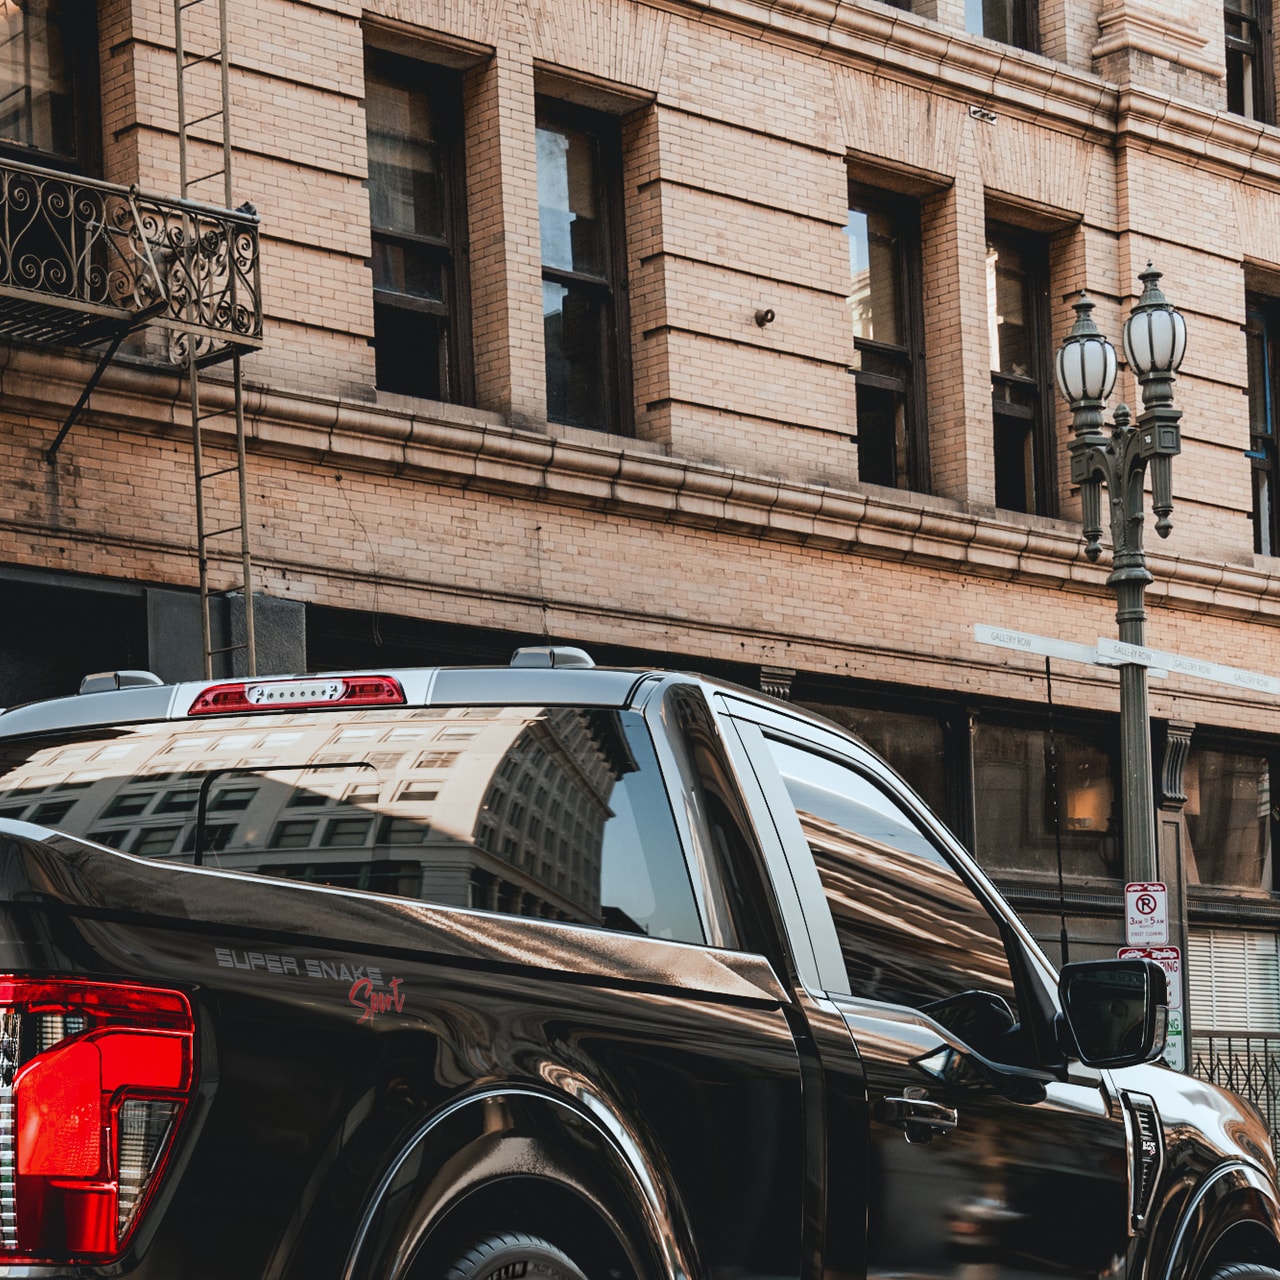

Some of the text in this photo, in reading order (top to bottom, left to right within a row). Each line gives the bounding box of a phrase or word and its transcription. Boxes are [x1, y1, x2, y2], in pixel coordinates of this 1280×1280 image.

[991, 631, 1032, 648] GALLERY ROW
[1113, 645, 1152, 662] GALLERY ROW
[215, 948, 385, 986] SUPER SNAKE
[348, 975, 406, 1027] Sport
